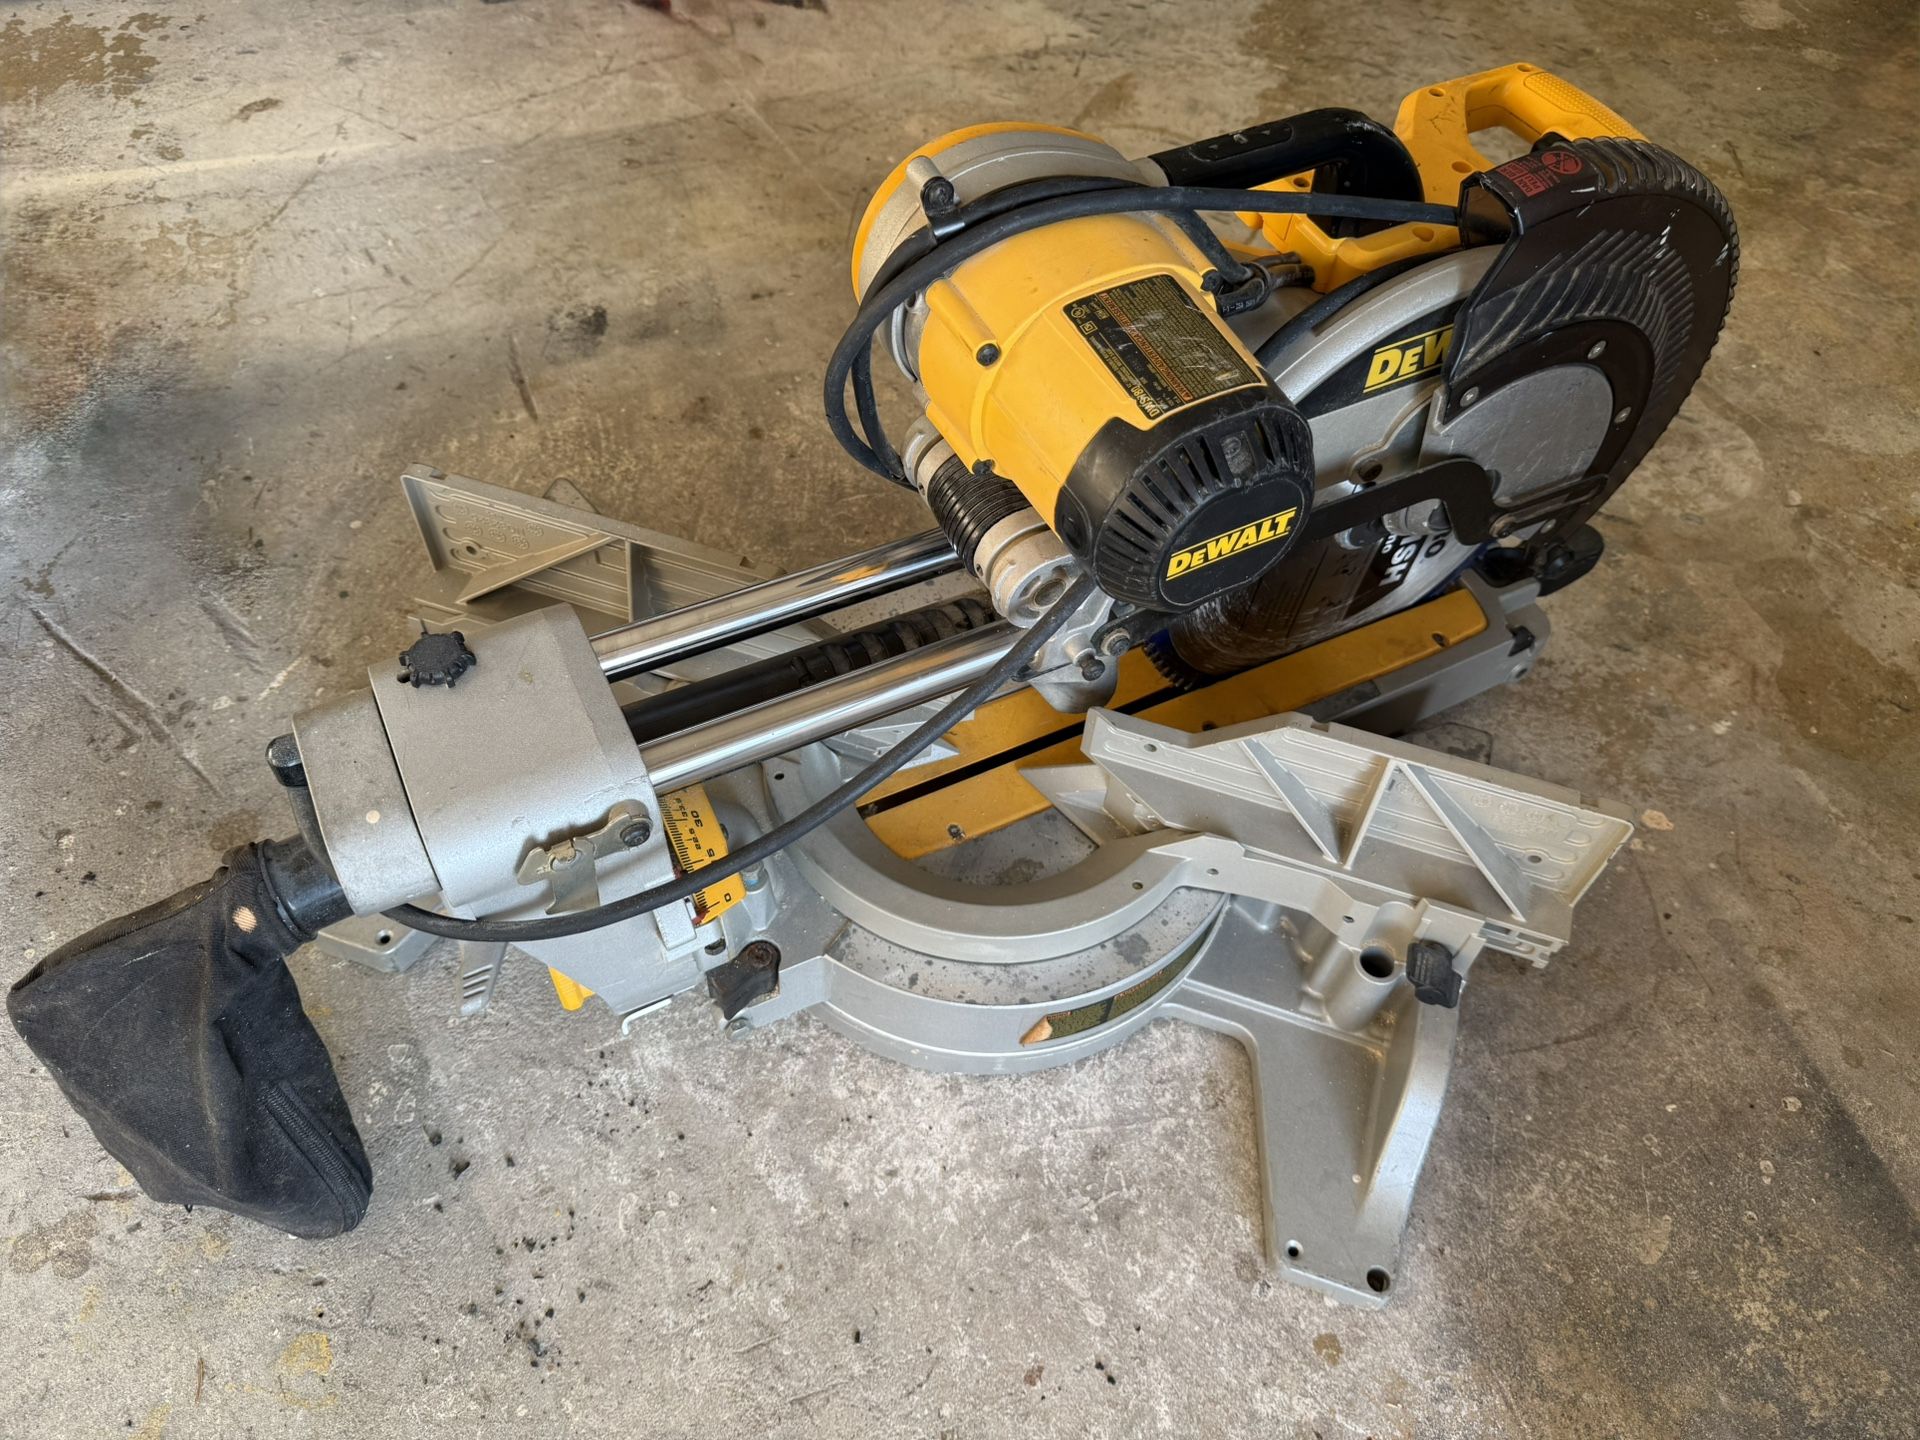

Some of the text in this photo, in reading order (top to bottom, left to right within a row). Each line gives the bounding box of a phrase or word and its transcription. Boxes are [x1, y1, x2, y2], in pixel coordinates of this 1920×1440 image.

[1130, 384, 1160, 417] DWS780
[1167, 511, 1295, 577] DEWALT
[691, 811, 703, 827] 30
[724, 892, 732, 902] 0
